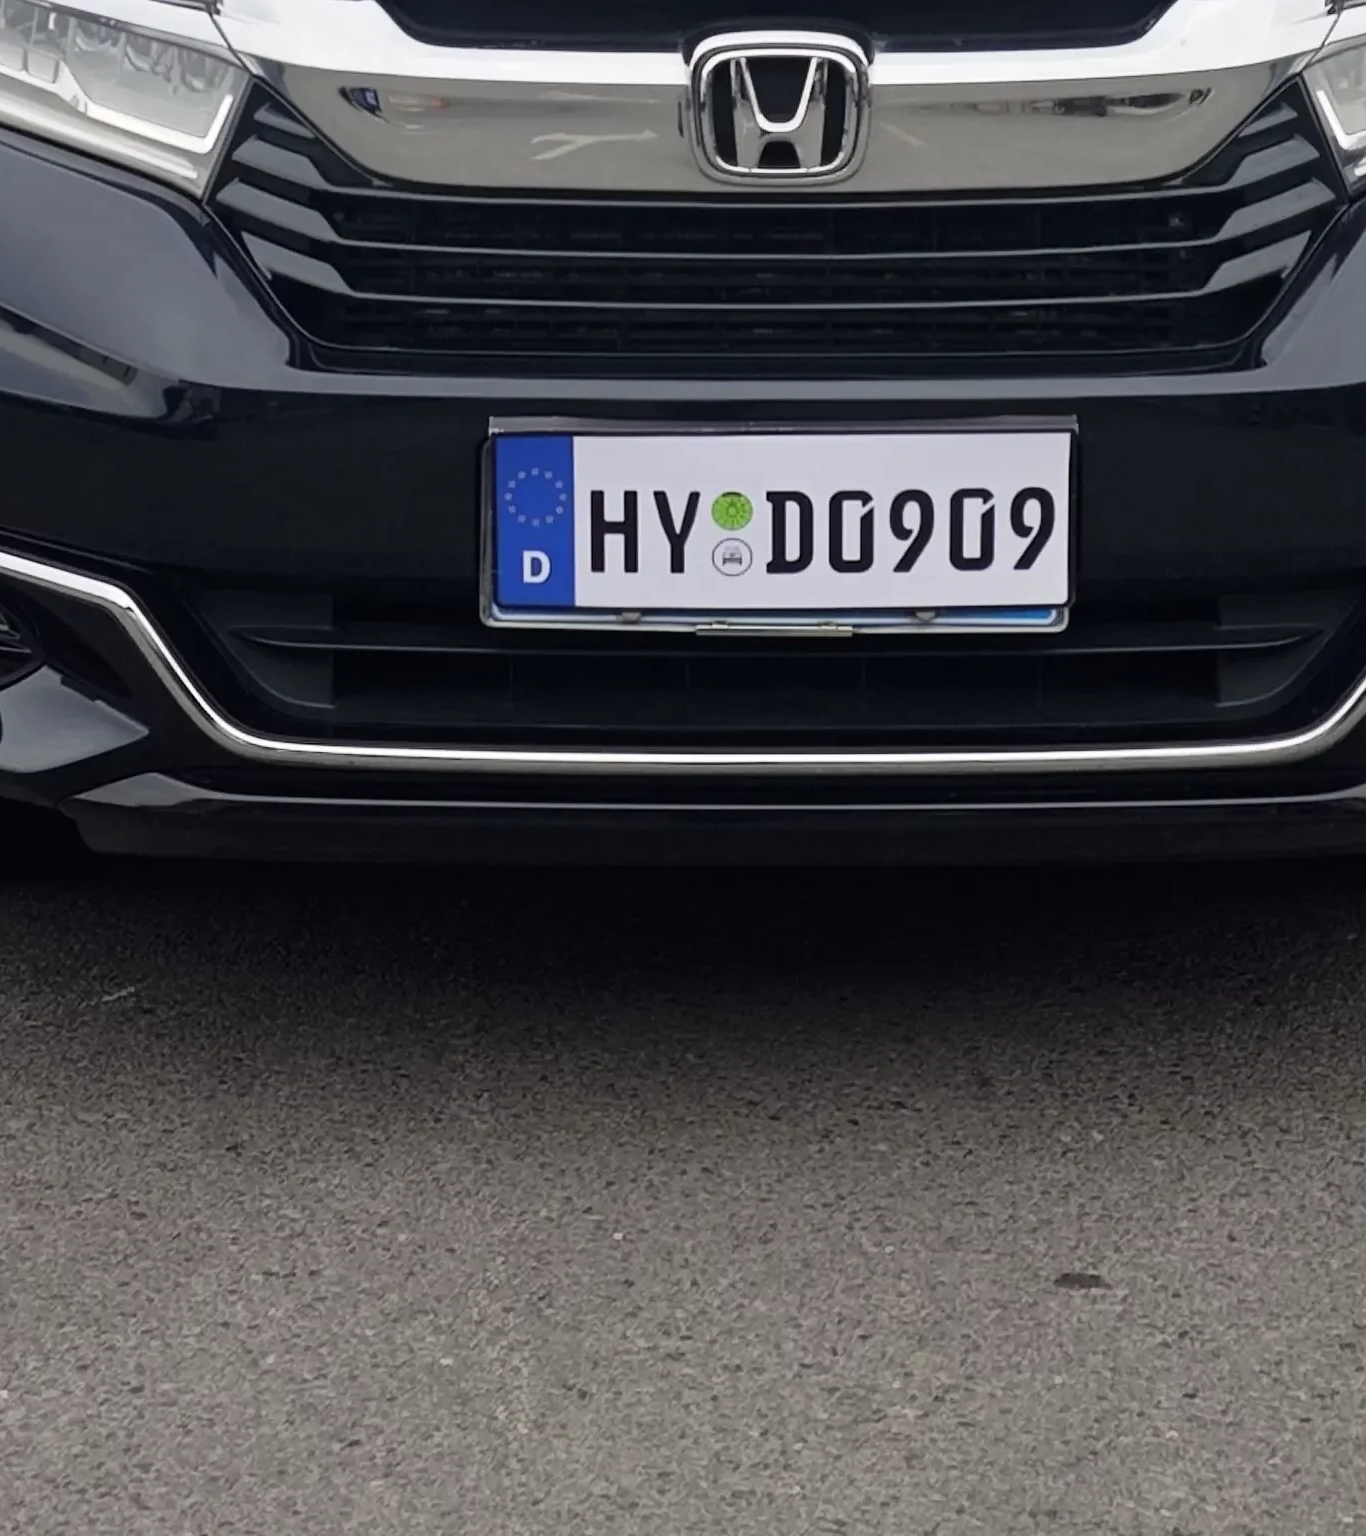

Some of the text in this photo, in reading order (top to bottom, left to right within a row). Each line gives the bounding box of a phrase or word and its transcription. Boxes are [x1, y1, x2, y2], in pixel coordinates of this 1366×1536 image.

[589, 486, 1056, 574] HY D0909
[522, 550, 552, 584] D
